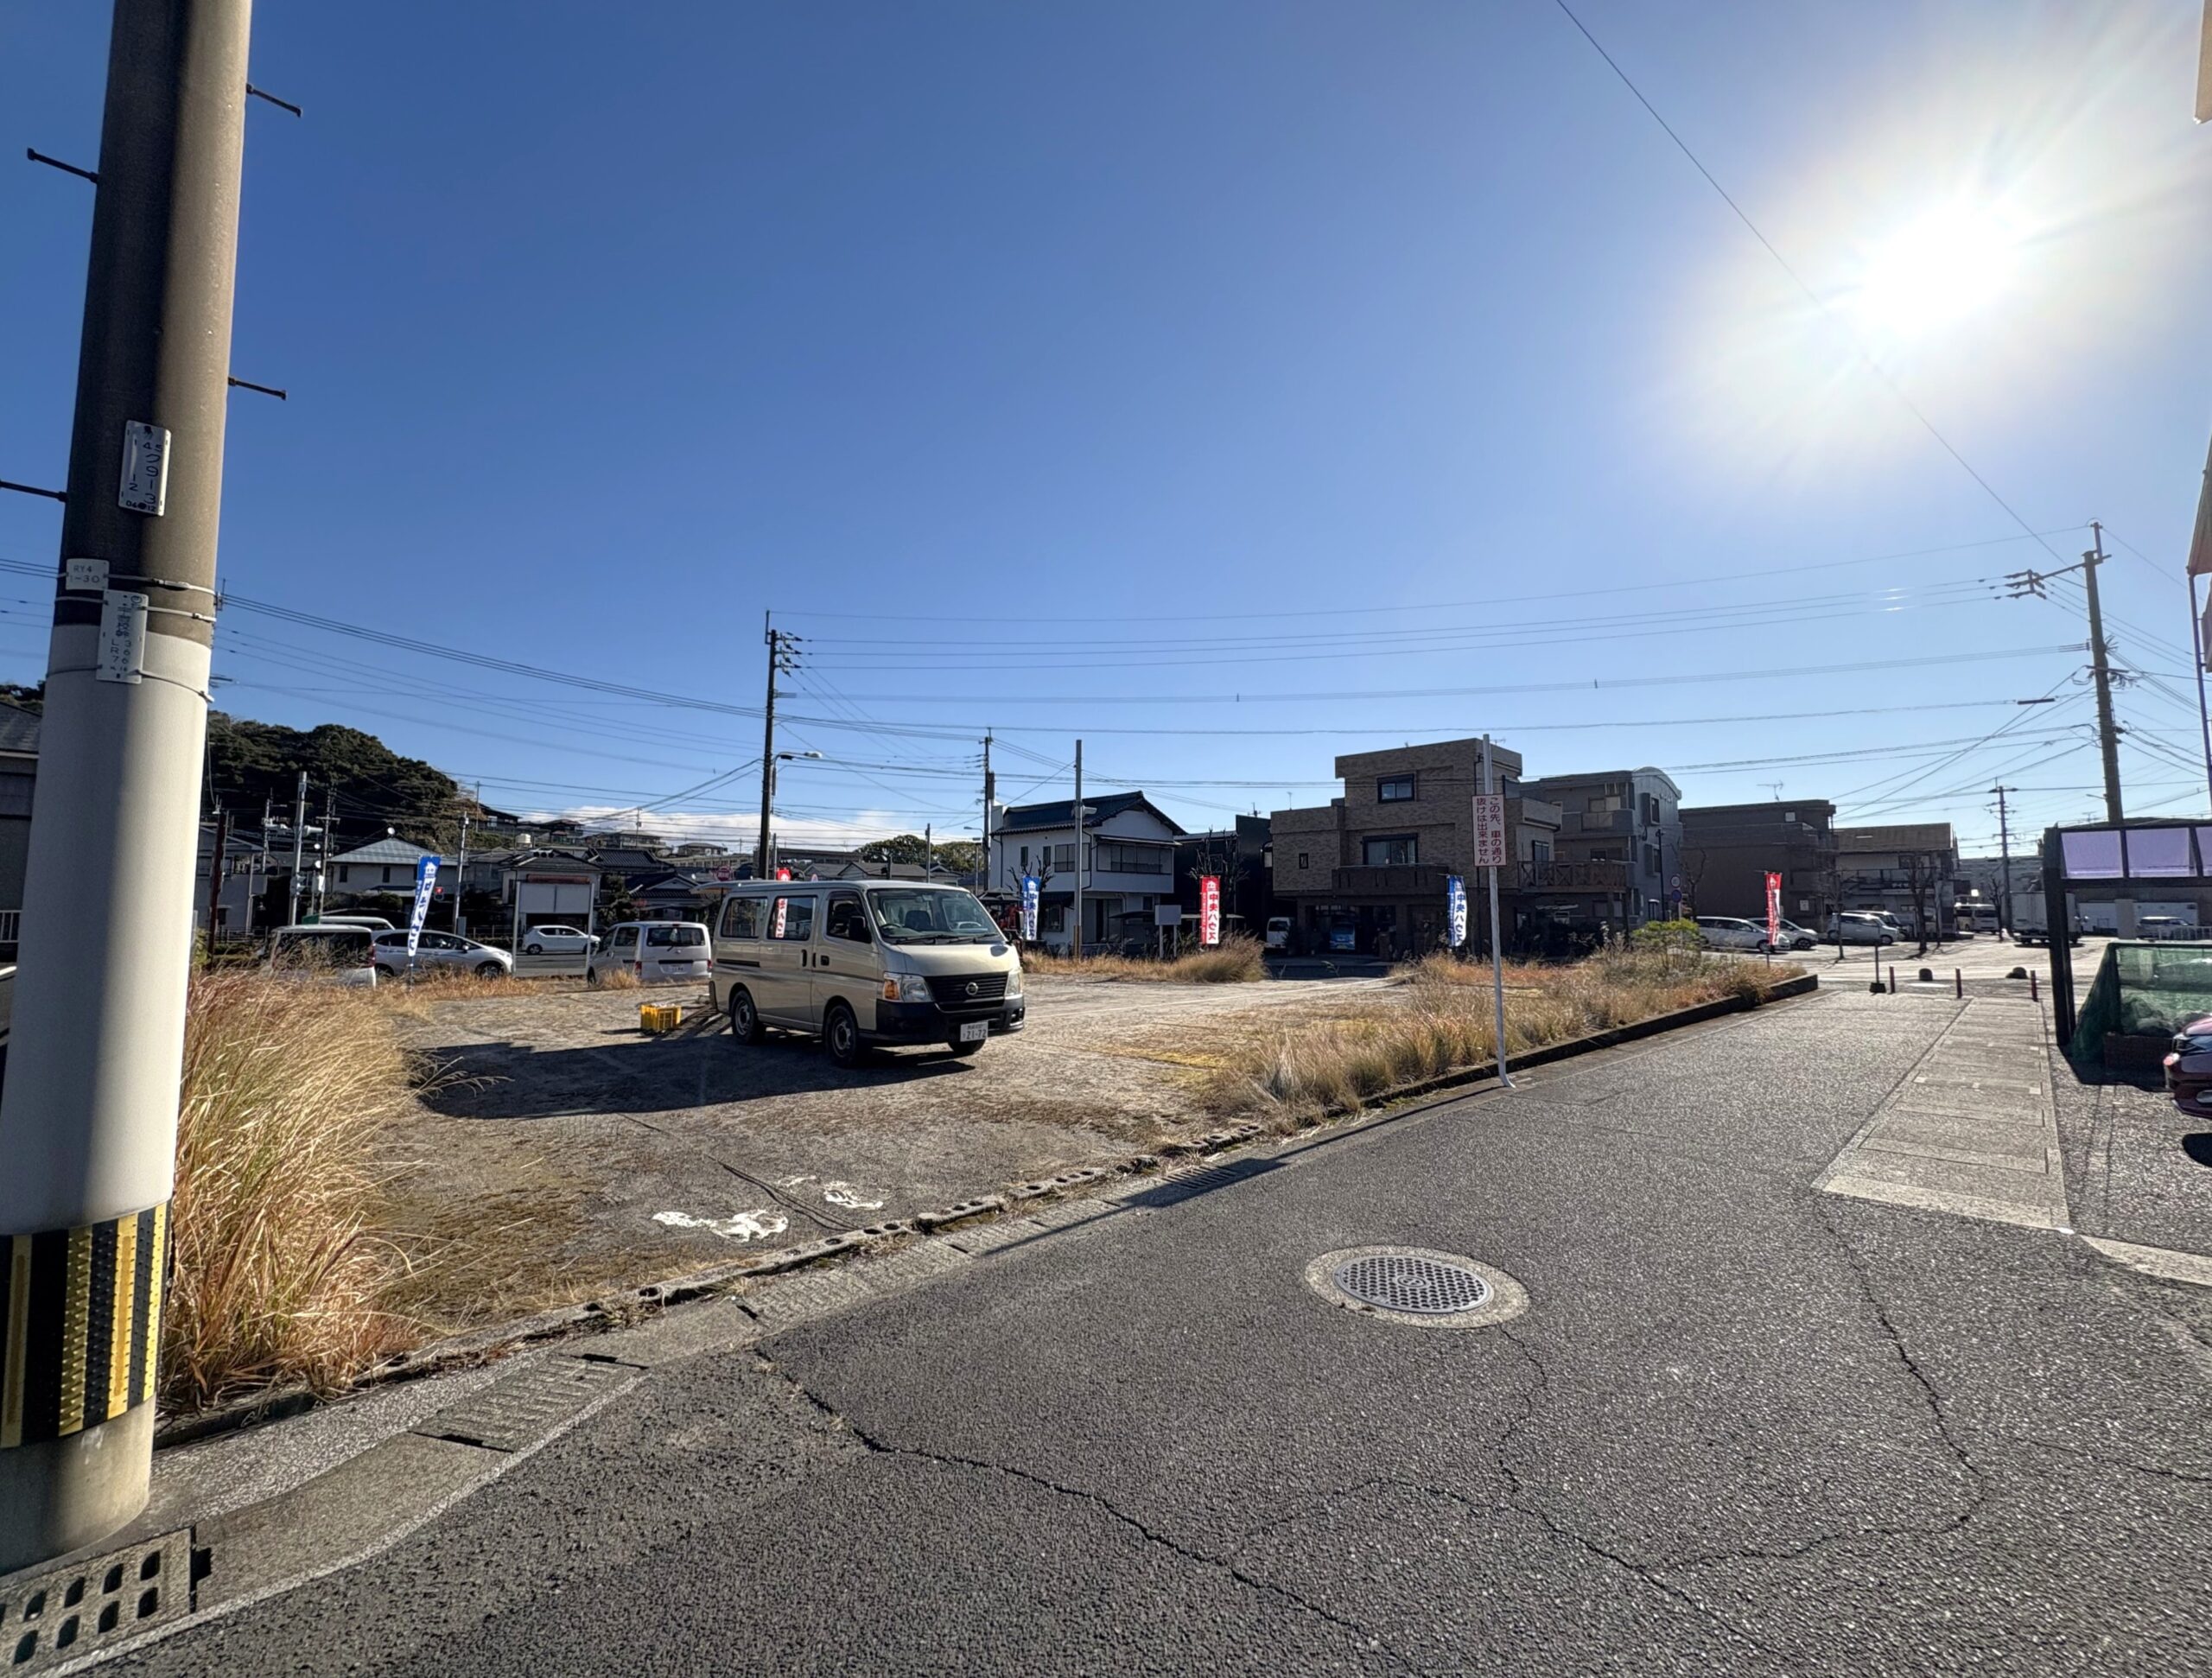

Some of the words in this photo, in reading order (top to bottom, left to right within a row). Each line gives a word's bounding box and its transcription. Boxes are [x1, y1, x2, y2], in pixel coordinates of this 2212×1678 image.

[1477, 798, 1489, 864] 抜けは出来ません
[1209, 893, 1217, 940] 中央ハウス
[1454, 893, 1465, 942] 中央ハウス
